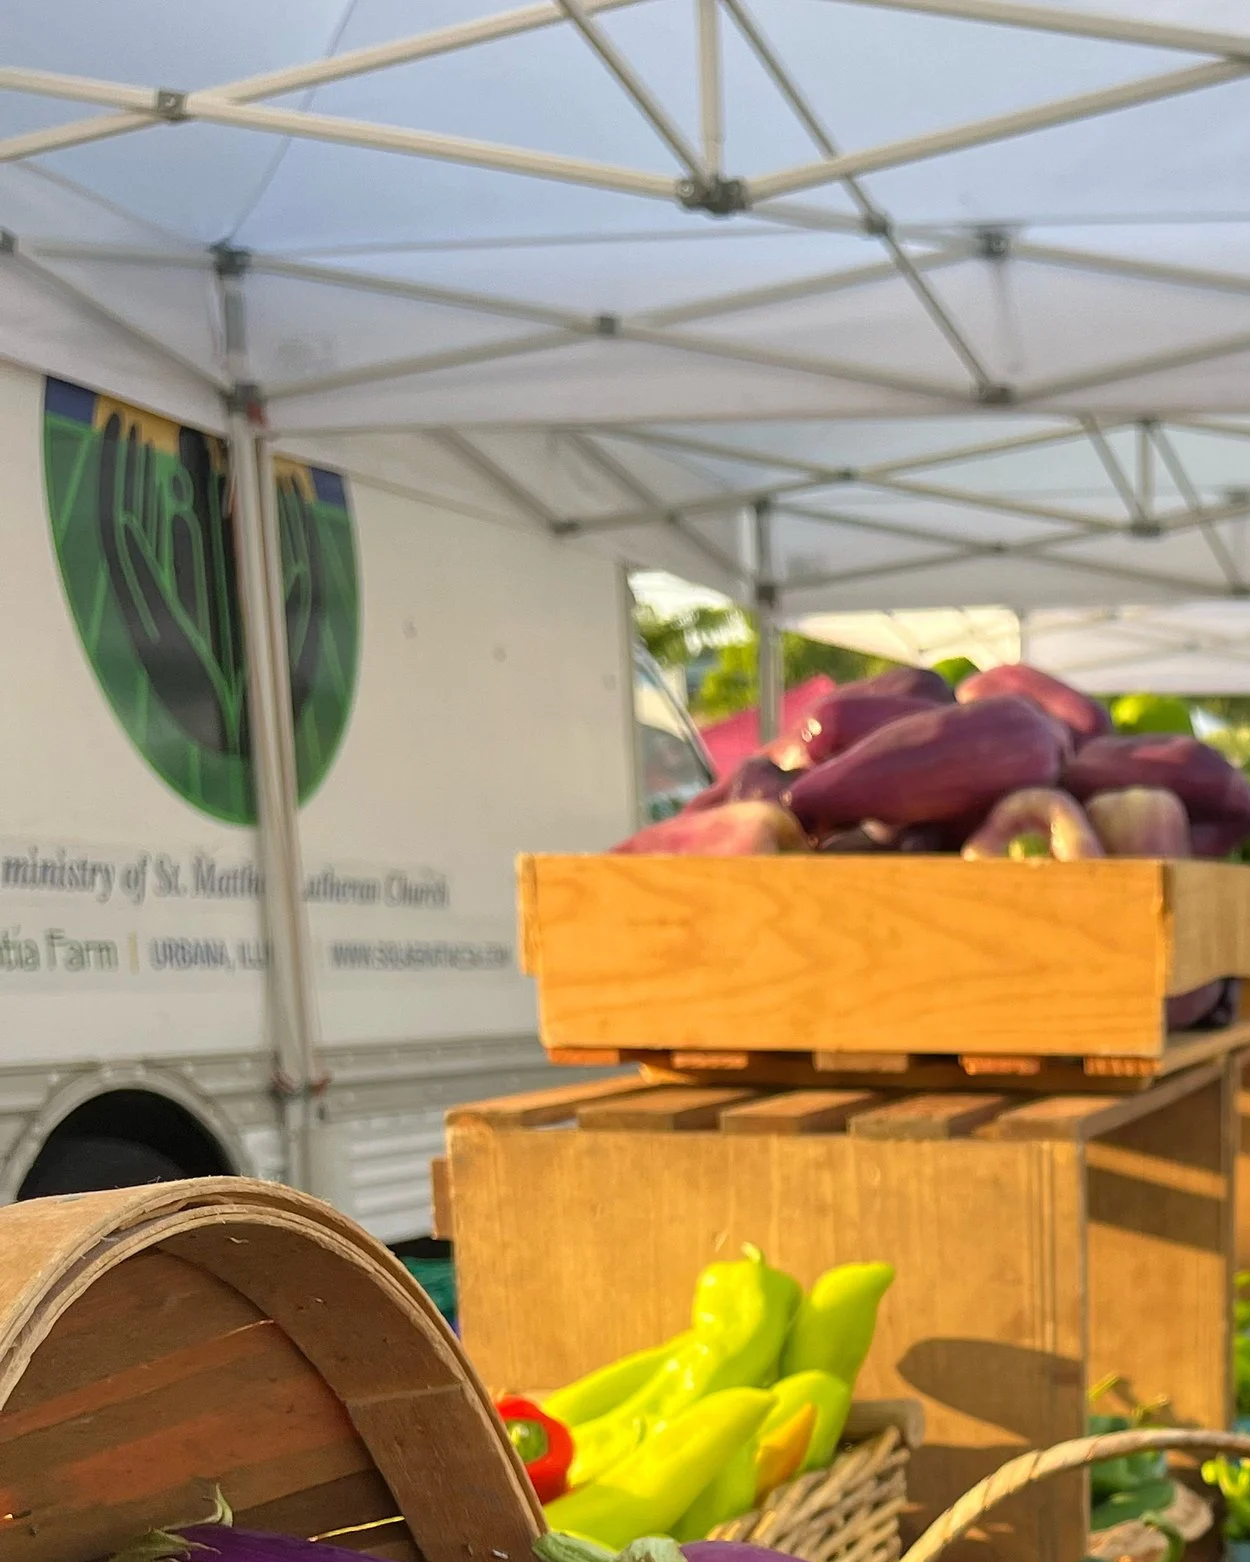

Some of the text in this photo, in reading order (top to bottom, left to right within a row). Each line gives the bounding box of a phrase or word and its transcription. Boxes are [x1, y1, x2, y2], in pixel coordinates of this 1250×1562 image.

[1, 846, 115, 904] ministry
[119, 851, 151, 906] of
[153, 852, 187, 898] St.
[43, 927, 119, 973] Farm
